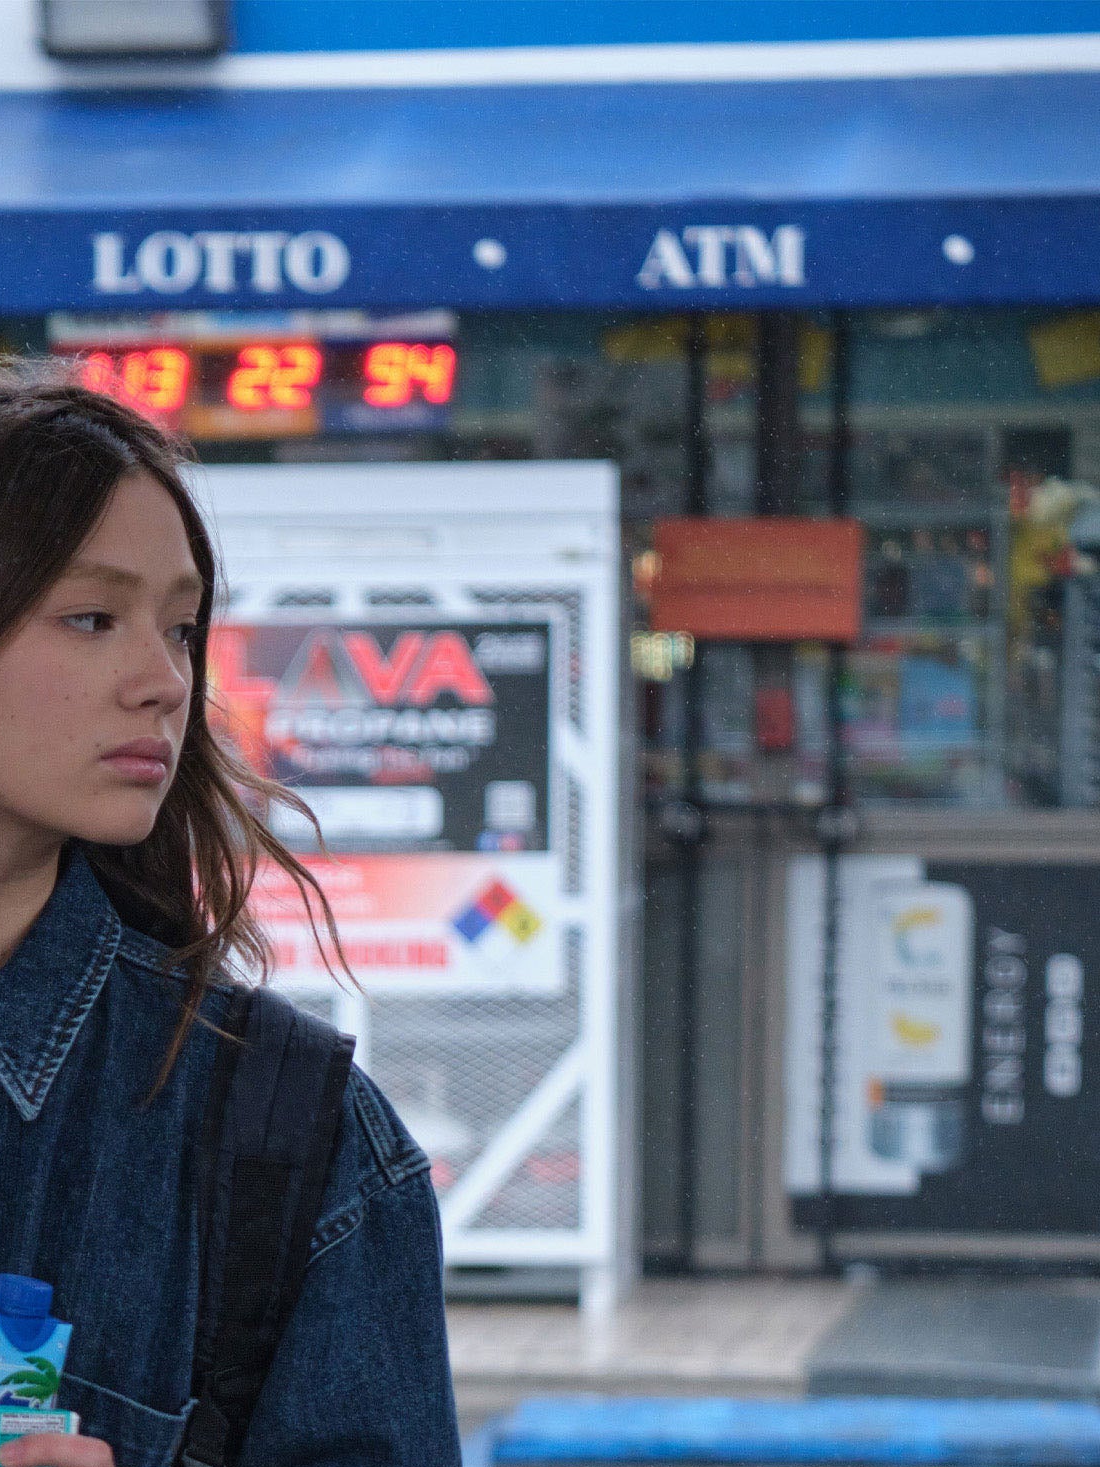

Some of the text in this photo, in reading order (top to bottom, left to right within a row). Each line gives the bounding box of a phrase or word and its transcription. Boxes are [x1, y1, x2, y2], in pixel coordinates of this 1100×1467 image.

[93, 230, 350, 294] LOTTO
[637, 224, 808, 289] ATM
[227, 344, 322, 410] 22
[209, 628, 496, 706] LAVA
[265, 707, 497, 746] PROPANE
[982, 927, 1028, 1126] ENERGY
